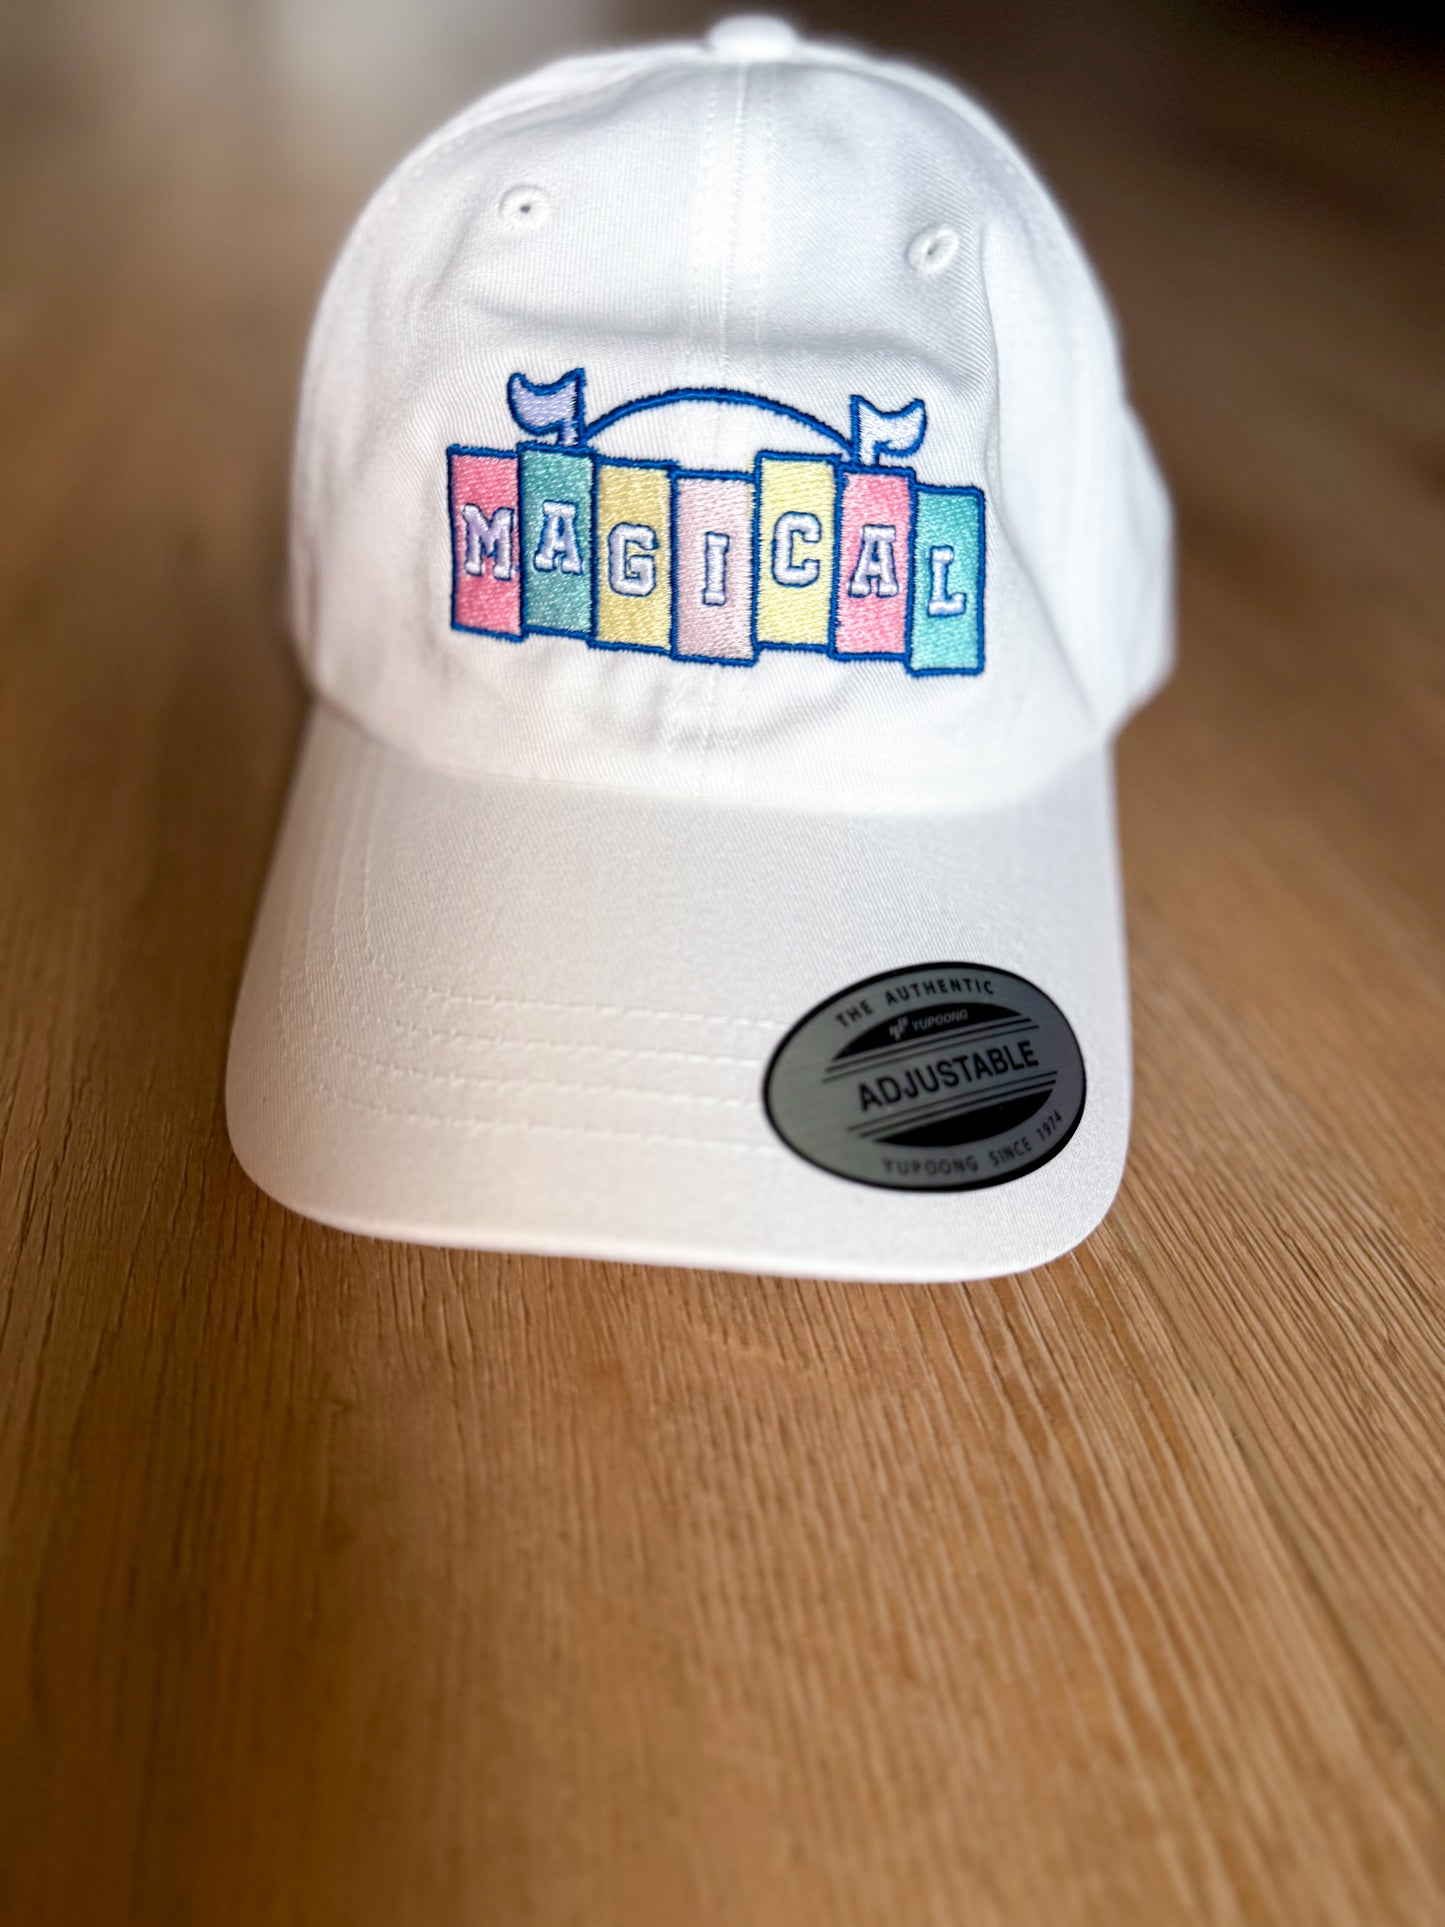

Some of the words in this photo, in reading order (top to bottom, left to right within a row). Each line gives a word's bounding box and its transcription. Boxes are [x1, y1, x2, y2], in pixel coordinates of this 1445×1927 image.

[460, 501, 967, 617] MAGICAL
[835, 1002, 874, 1029] THE
[885, 977, 995, 1005] AUTHENTIC
[911, 1008, 969, 1032] YUPOONG
[858, 1040, 1039, 1112] ADJUSTABLE
[883, 1156, 979, 1176] YUPOONG
[989, 1136, 1033, 1167] SINCE
[1037, 1110, 1063, 1142] 1974
